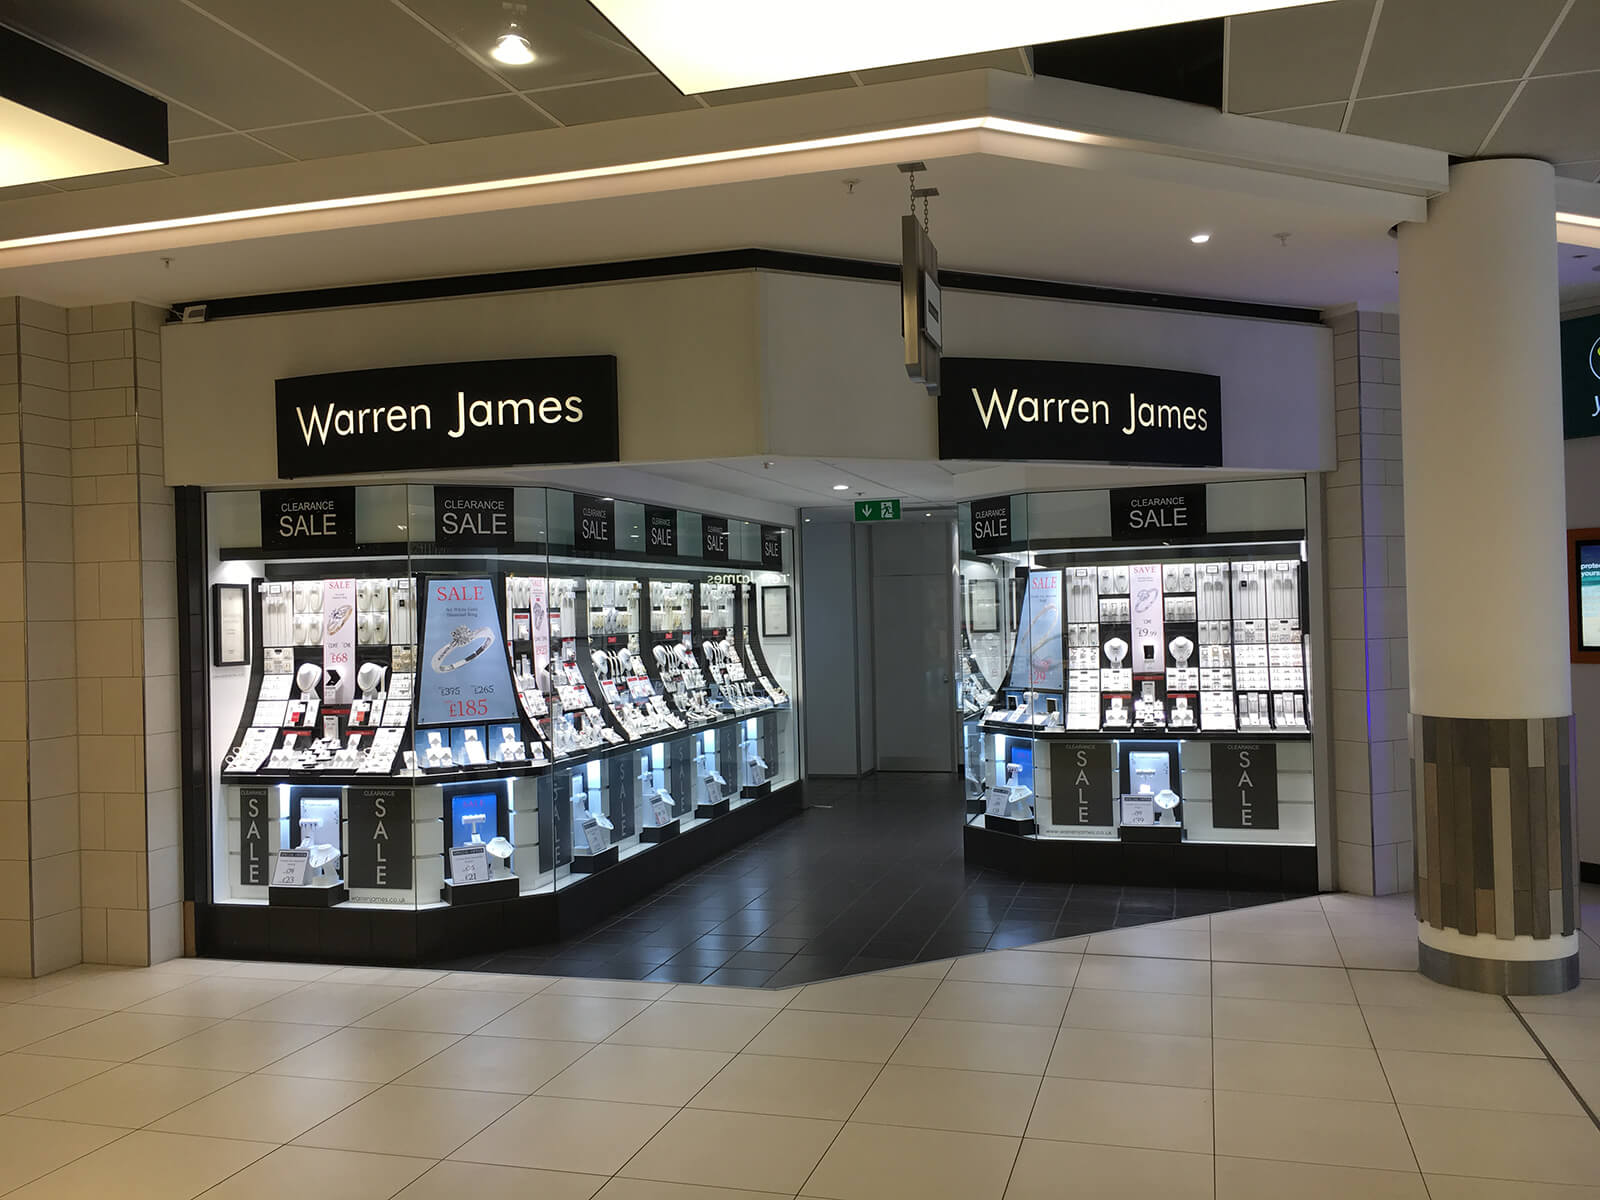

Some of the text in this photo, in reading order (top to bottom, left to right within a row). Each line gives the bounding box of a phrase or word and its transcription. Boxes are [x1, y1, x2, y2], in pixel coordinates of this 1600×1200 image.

[296, 391, 584, 447] Warren James
[971, 387, 1208, 435] Warren James
[281, 501, 334, 512] CLEARANCE
[444, 500, 505, 511] CLEARANCE
[1131, 496, 1185, 508] CLEARANCE
[582, 507, 607, 517] CLEARANCE
[976, 507, 1006, 519] CLEARANCE
[1129, 507, 1188, 529] SALE
[279, 514, 337, 537] SALE
[442, 513, 507, 535] SALE
[582, 519, 608, 541] SALE
[974, 519, 1008, 539] SALE
[651, 527, 672, 546] SALE
[707, 534, 724, 551] SALE
[764, 542, 779, 557] SALE
[1133, 566, 1157, 574] SAVE
[328, 581, 351, 590] SALE
[1032, 576, 1057, 589] SALE
[437, 586, 484, 601] SALE
[449, 699, 488, 717] £185
[1075, 751, 1090, 822] SALE
[1237, 751, 1253, 825] SALE
[247, 798, 261, 883] SALE
[373, 798, 388, 885] SALE
